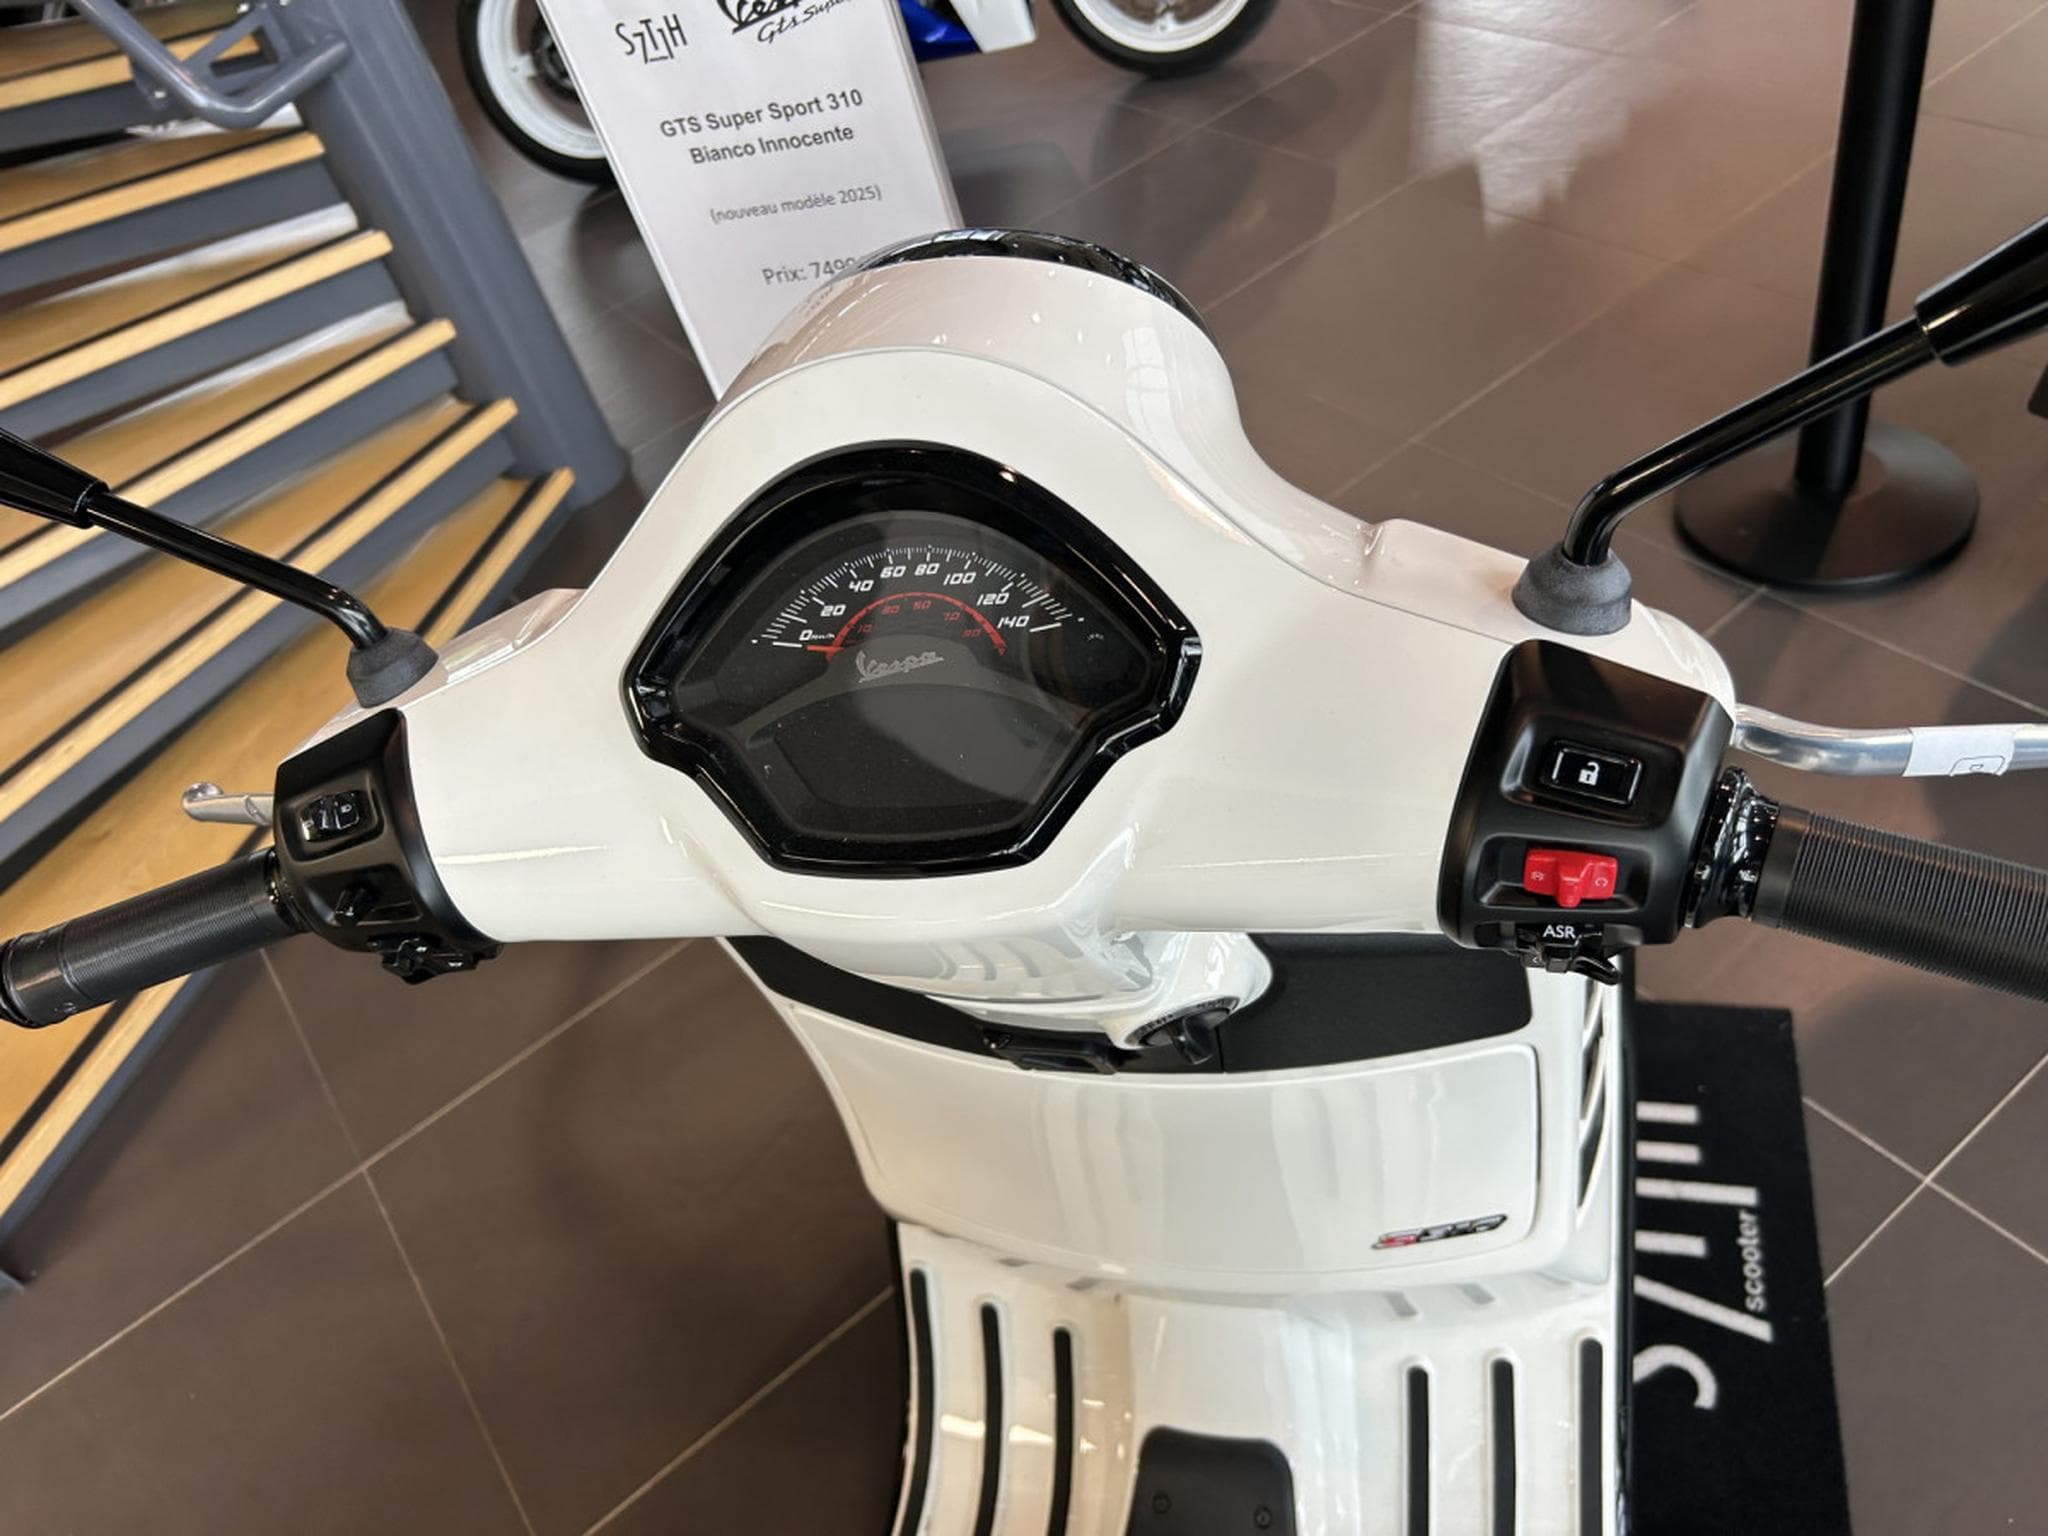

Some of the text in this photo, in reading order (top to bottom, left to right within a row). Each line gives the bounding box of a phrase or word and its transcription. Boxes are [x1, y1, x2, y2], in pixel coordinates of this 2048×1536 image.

[660, 88, 864, 138] GTS Super Sport 310
[689, 124, 855, 165] Bianco Innocente
[710, 184, 883, 225] (nouveau modèle 2025)
[762, 266, 808, 286] Prix:
[880, 565, 907, 578] 60
[914, 563, 940, 576] 80
[848, 579, 875, 592] 40
[943, 571, 977, 586] 100
[976, 592, 1010, 607] 120
[820, 604, 847, 617] 20
[997, 613, 1031, 629] 140
[799, 629, 813, 641] 0
[855, 650, 944, 684] Vespa
[1542, 924, 1577, 939] ASR
[1736, 1208, 1766, 1313] scooter
